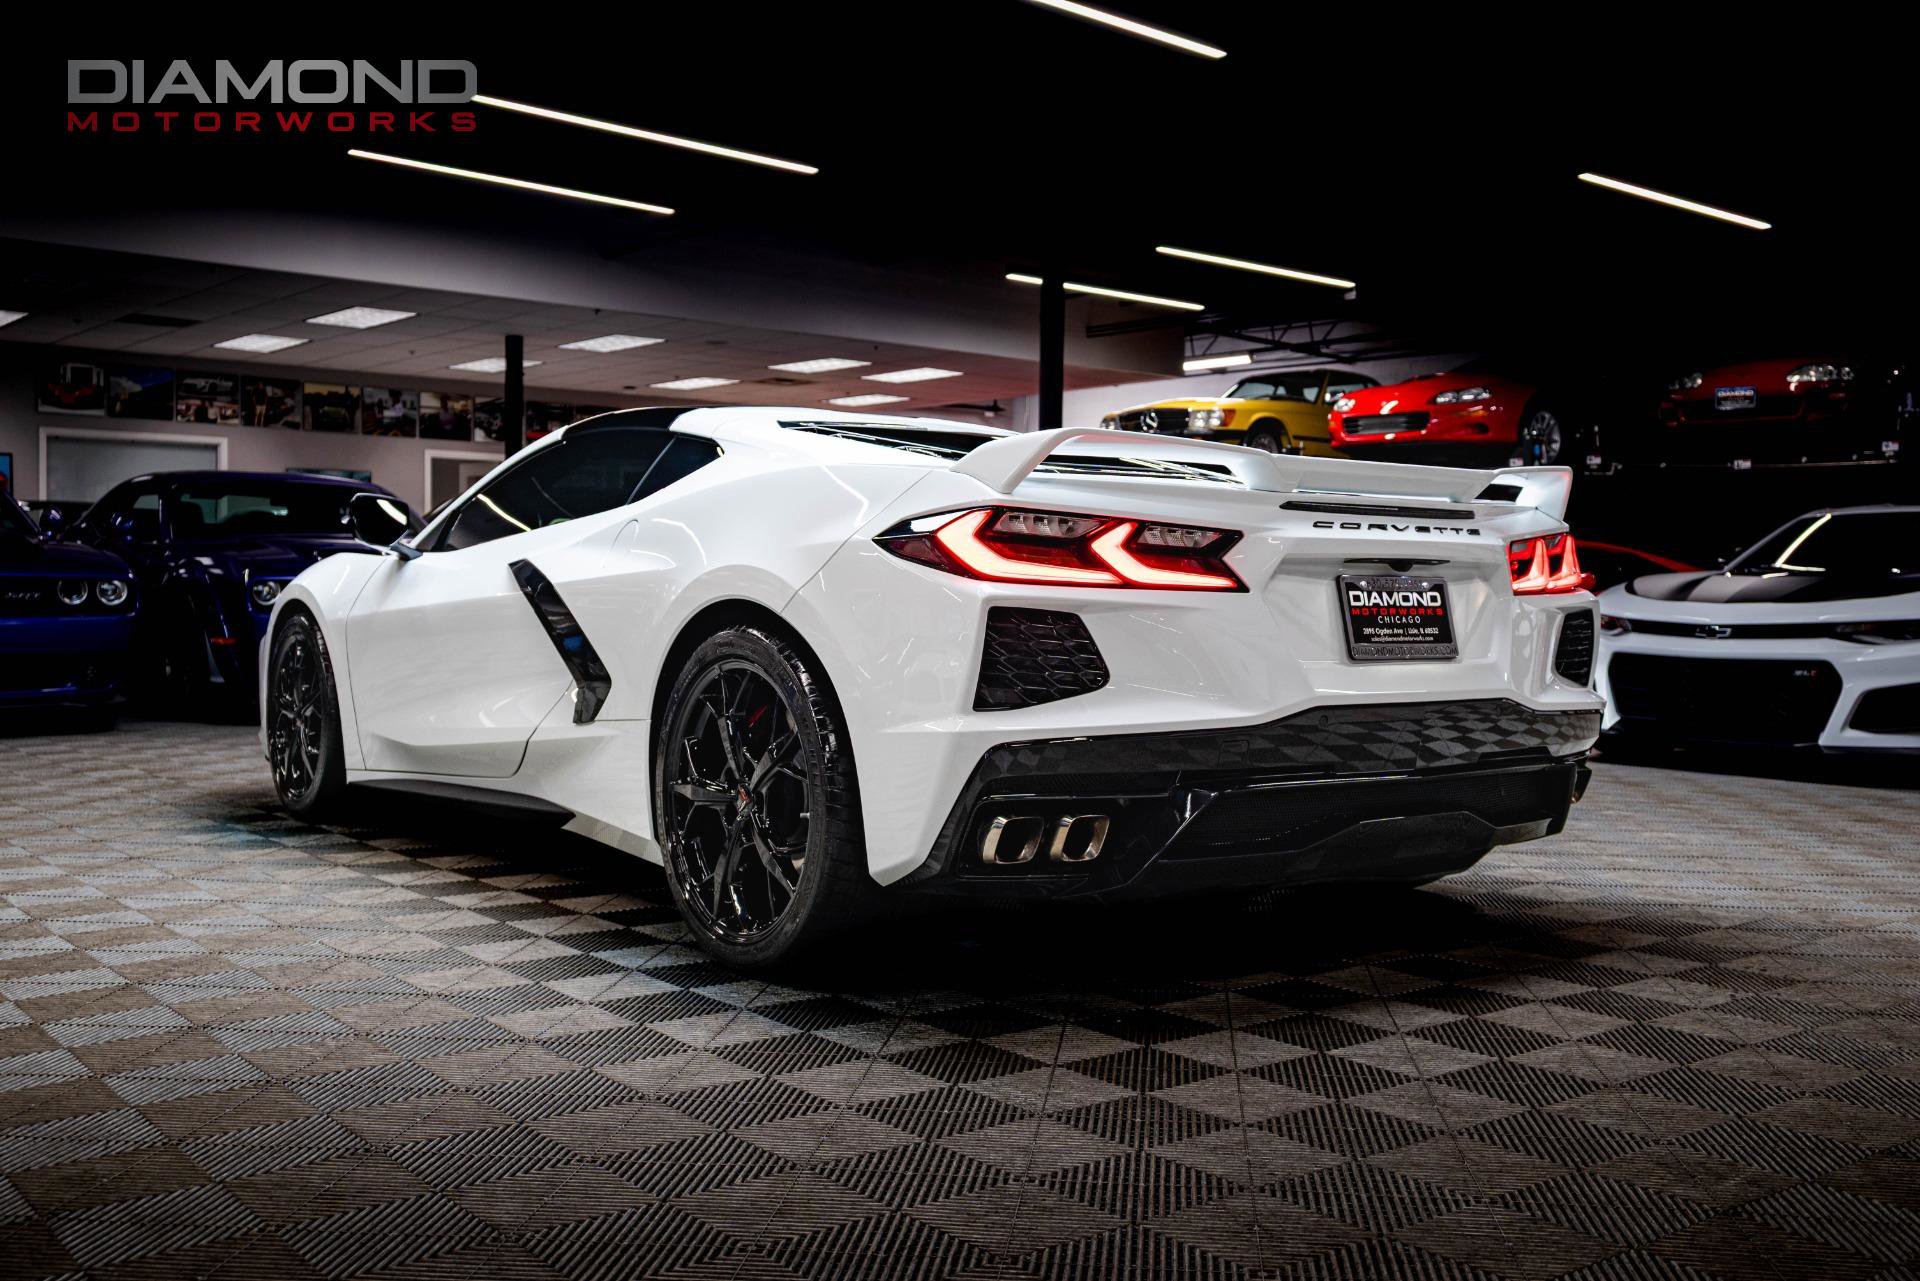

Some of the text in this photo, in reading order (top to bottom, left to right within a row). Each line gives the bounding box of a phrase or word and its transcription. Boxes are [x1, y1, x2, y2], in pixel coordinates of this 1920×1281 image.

[1312, 521, 1481, 536] CORVETTE
[1348, 591, 1442, 607] DIAMOND
[1351, 607, 1444, 616] MOTORWORKS
[1377, 615, 1421, 624] CHICAGO
[1375, 627, 1393, 636] Ogden
